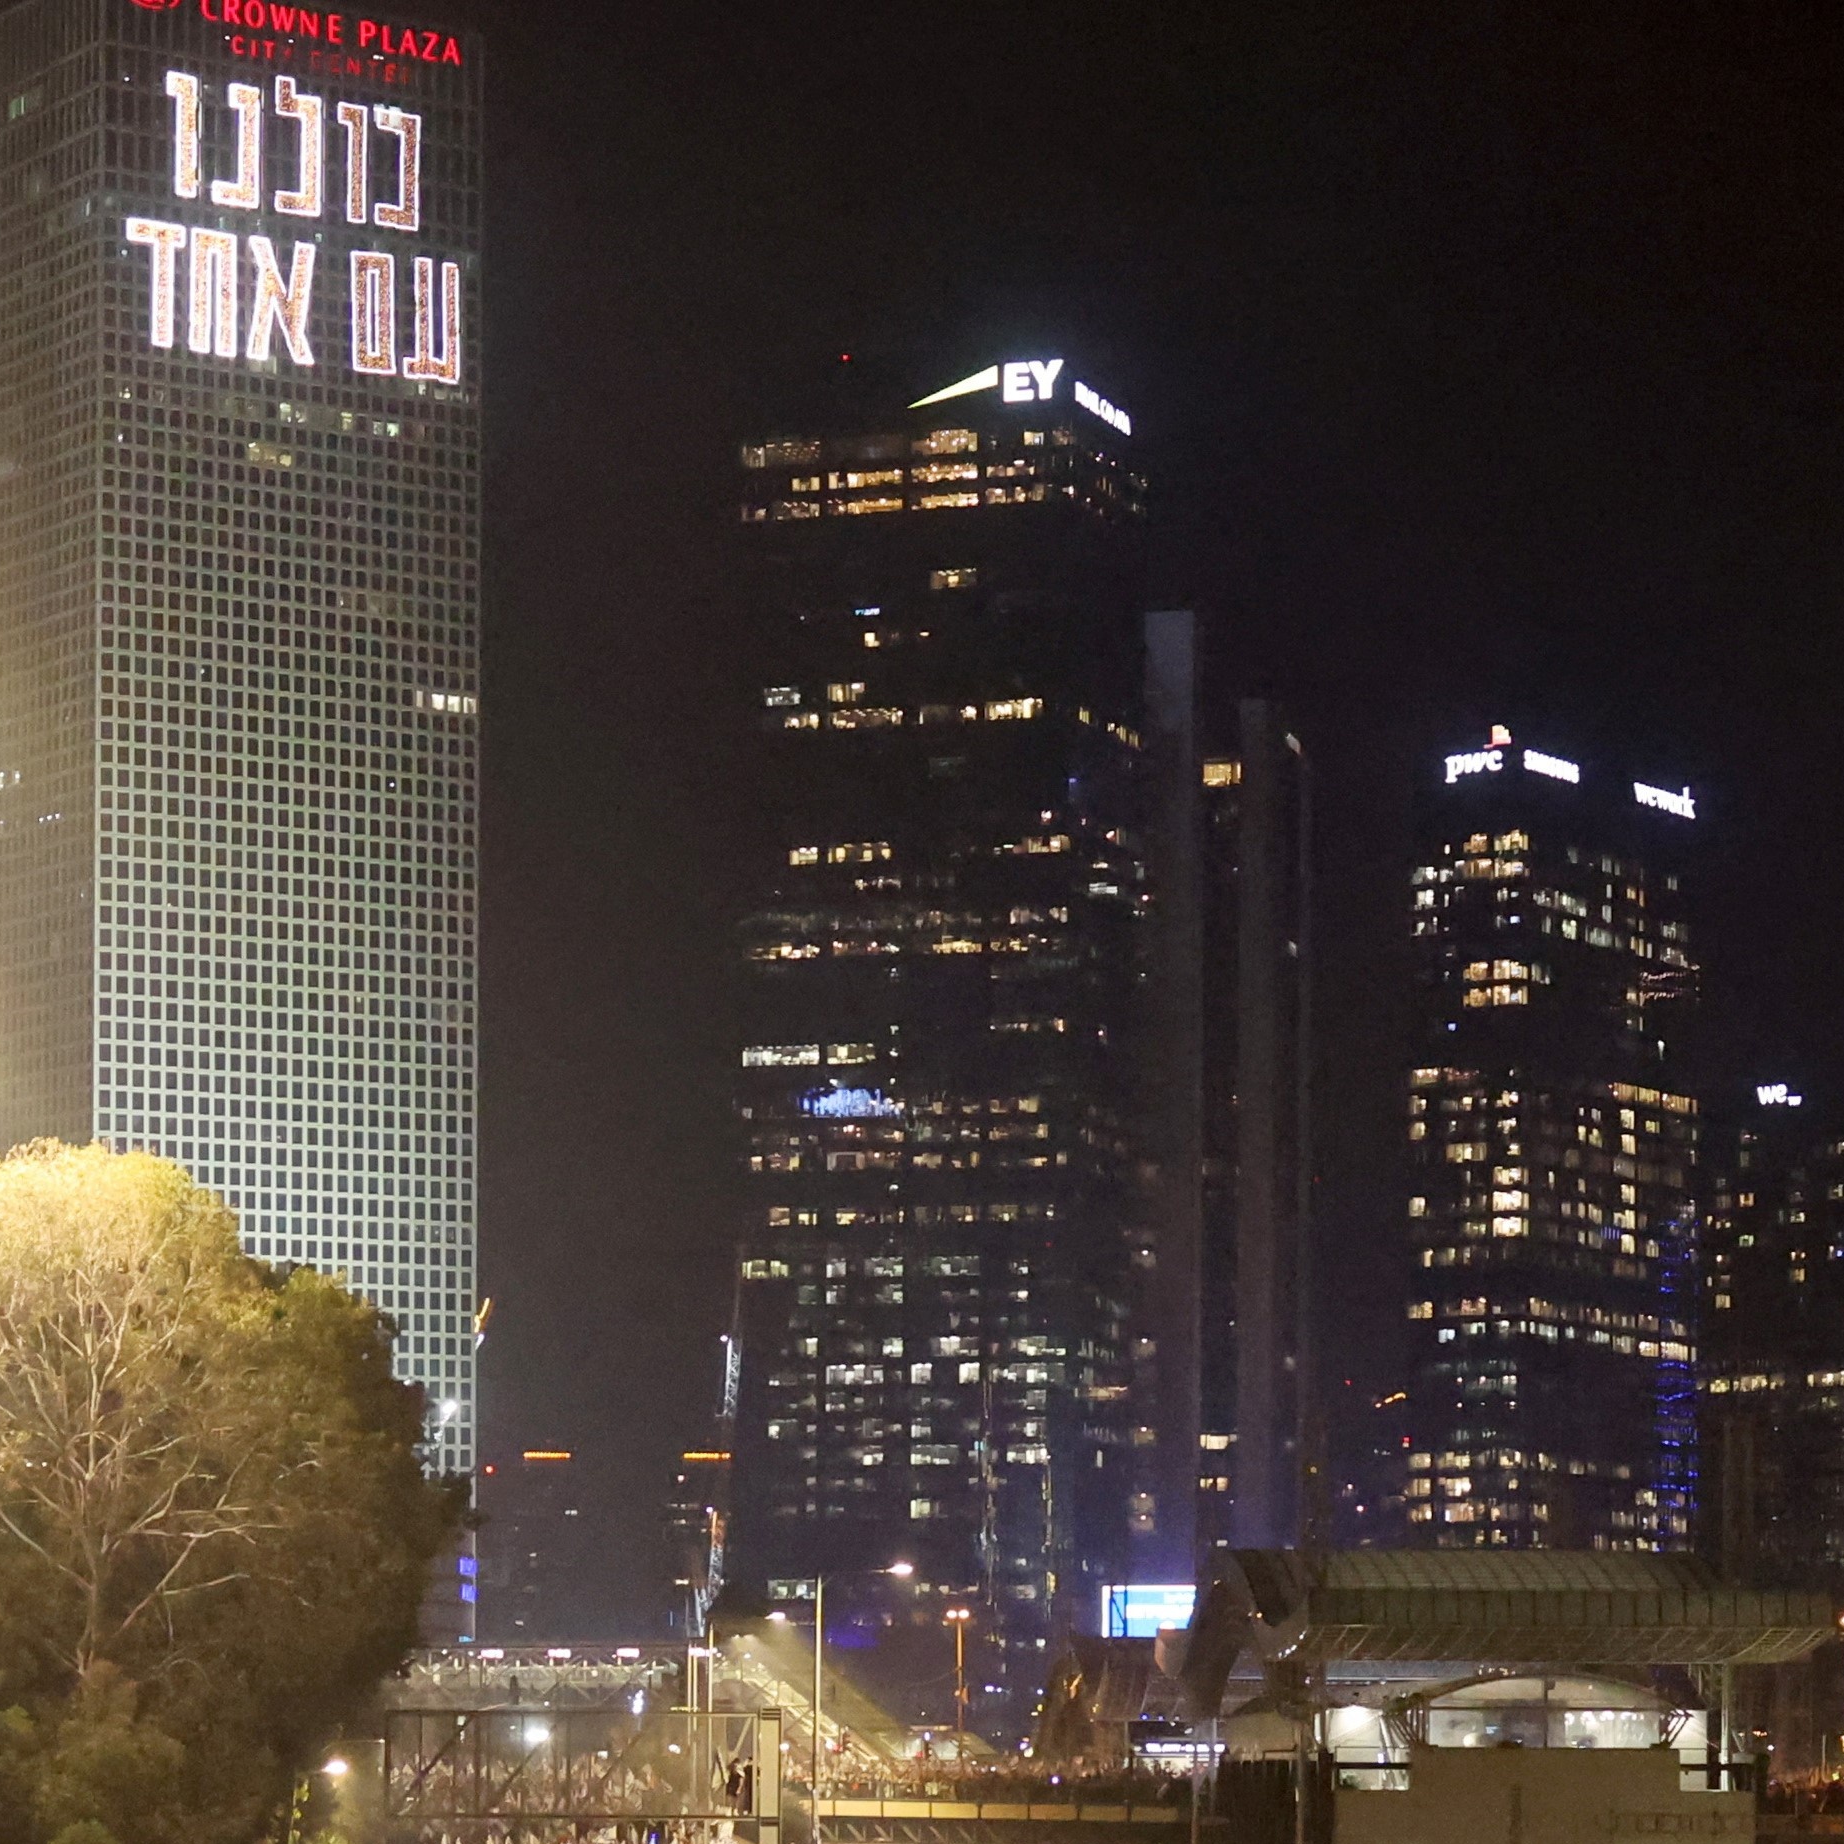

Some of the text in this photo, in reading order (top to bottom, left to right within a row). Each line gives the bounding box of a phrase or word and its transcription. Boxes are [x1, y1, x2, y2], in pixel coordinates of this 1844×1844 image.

[201, 0, 461, 66] CROWNE PLAZA
[166, 70, 421, 231] כולנו
[125, 217, 460, 385] עם אחד
[1002, 358, 1064, 402] EY
[1444, 750, 1503, 784] pwc
